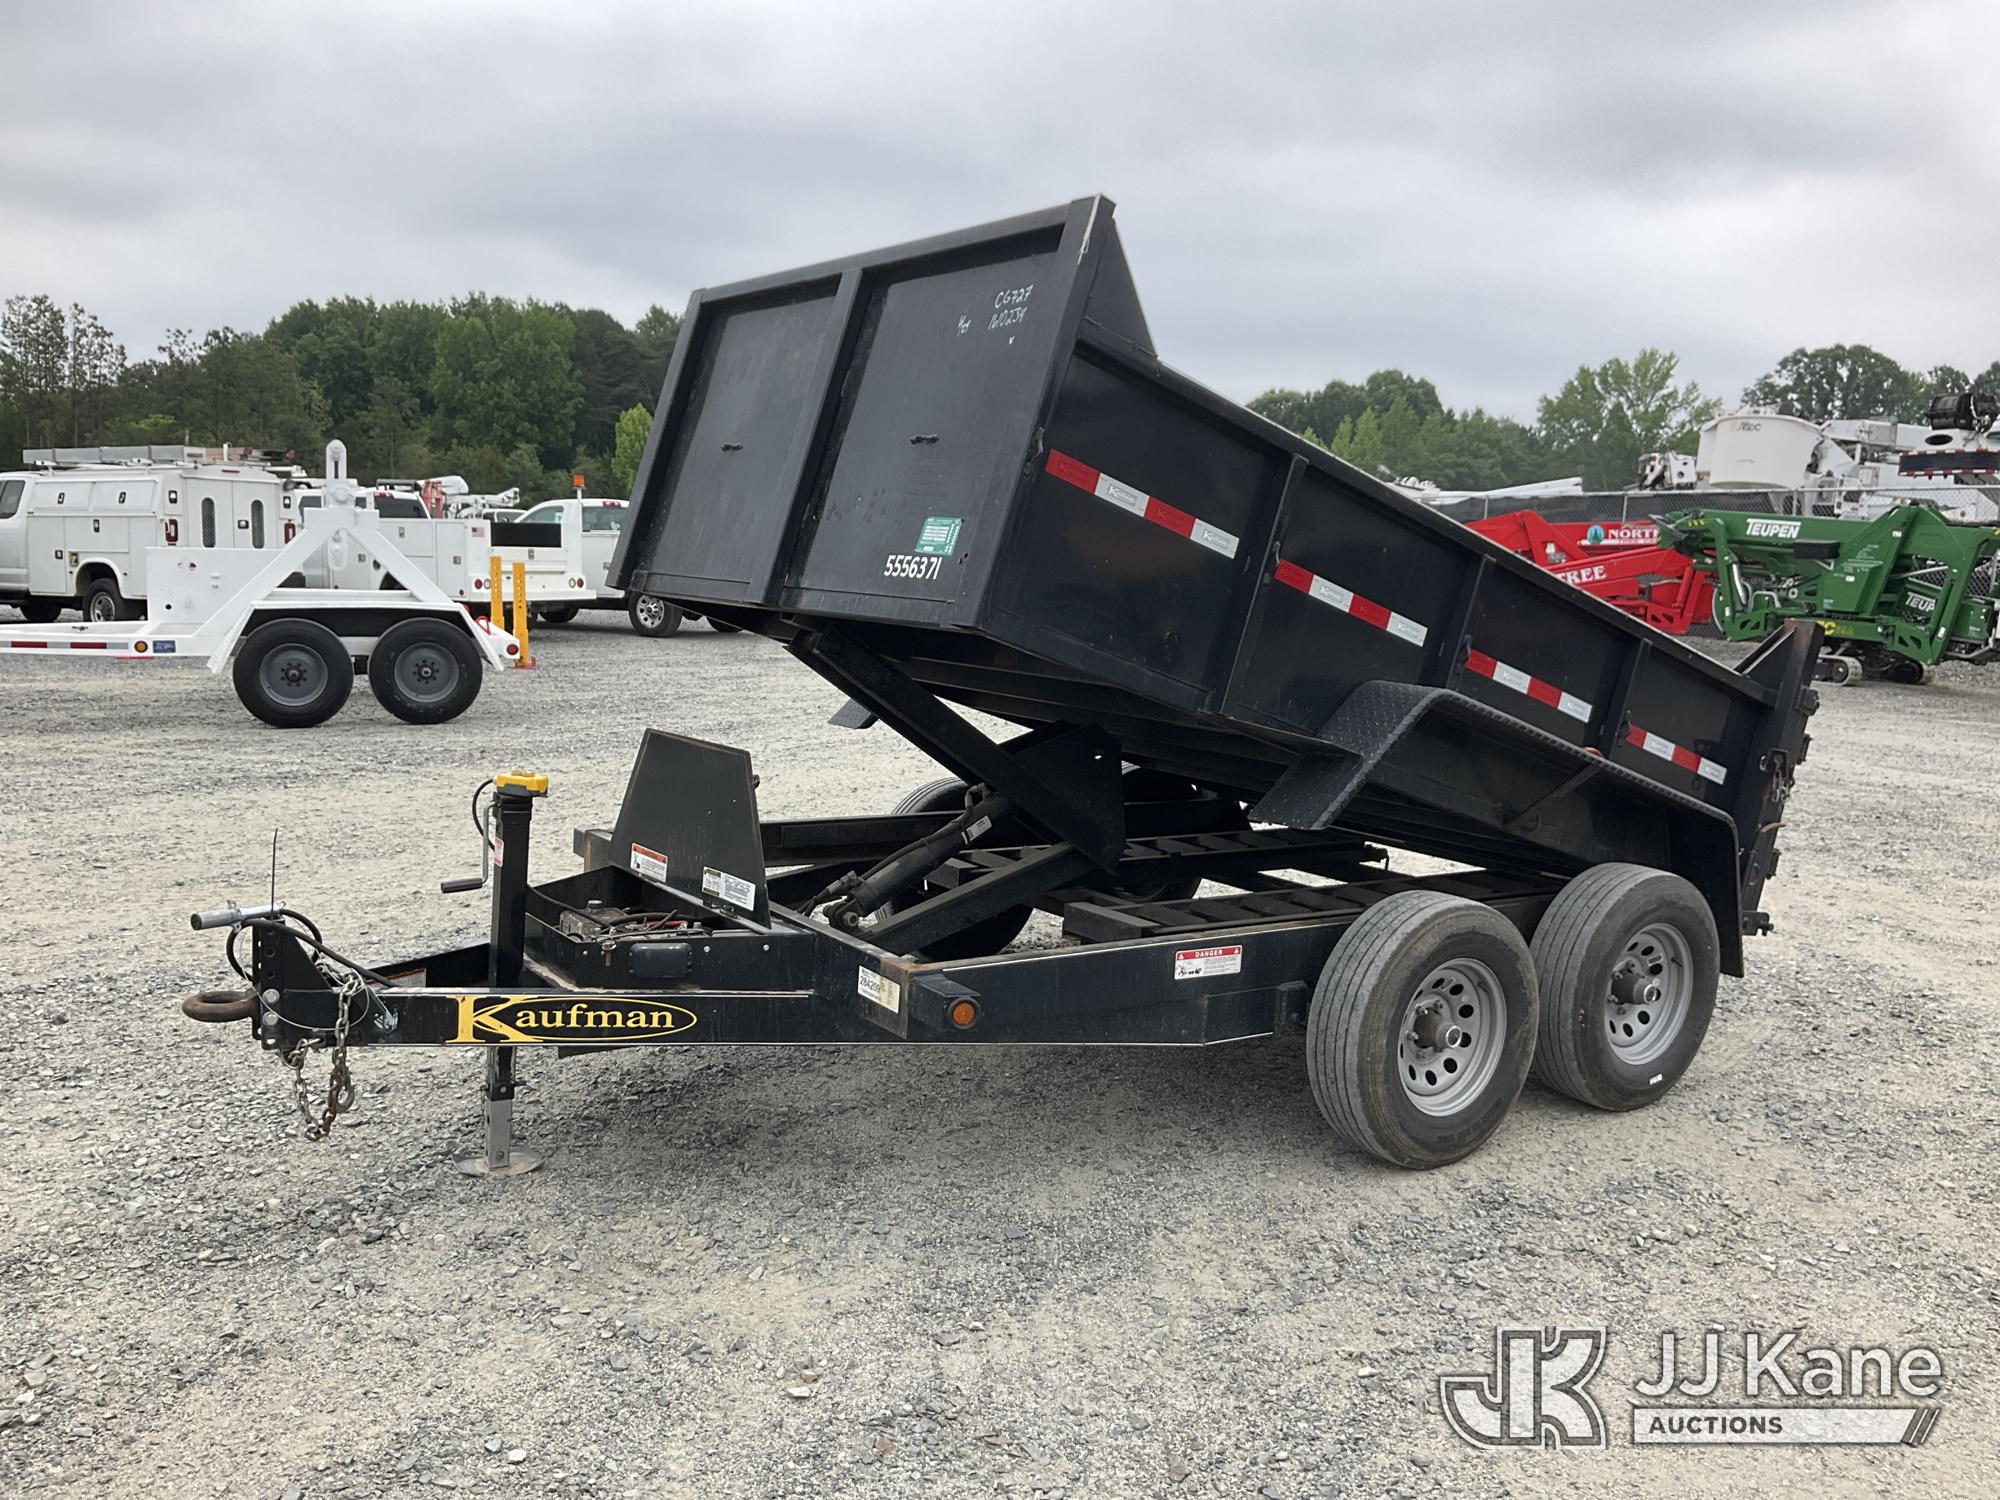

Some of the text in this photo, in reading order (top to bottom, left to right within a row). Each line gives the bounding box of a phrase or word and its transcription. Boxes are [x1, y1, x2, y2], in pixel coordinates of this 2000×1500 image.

[1746, 518, 1802, 539] TEUPEN
[883, 554, 943, 580] 5556371
[1905, 591, 1936, 612] TEUP
[1195, 949, 1223, 958] DANGER
[445, 995, 676, 1043] Kaufman
